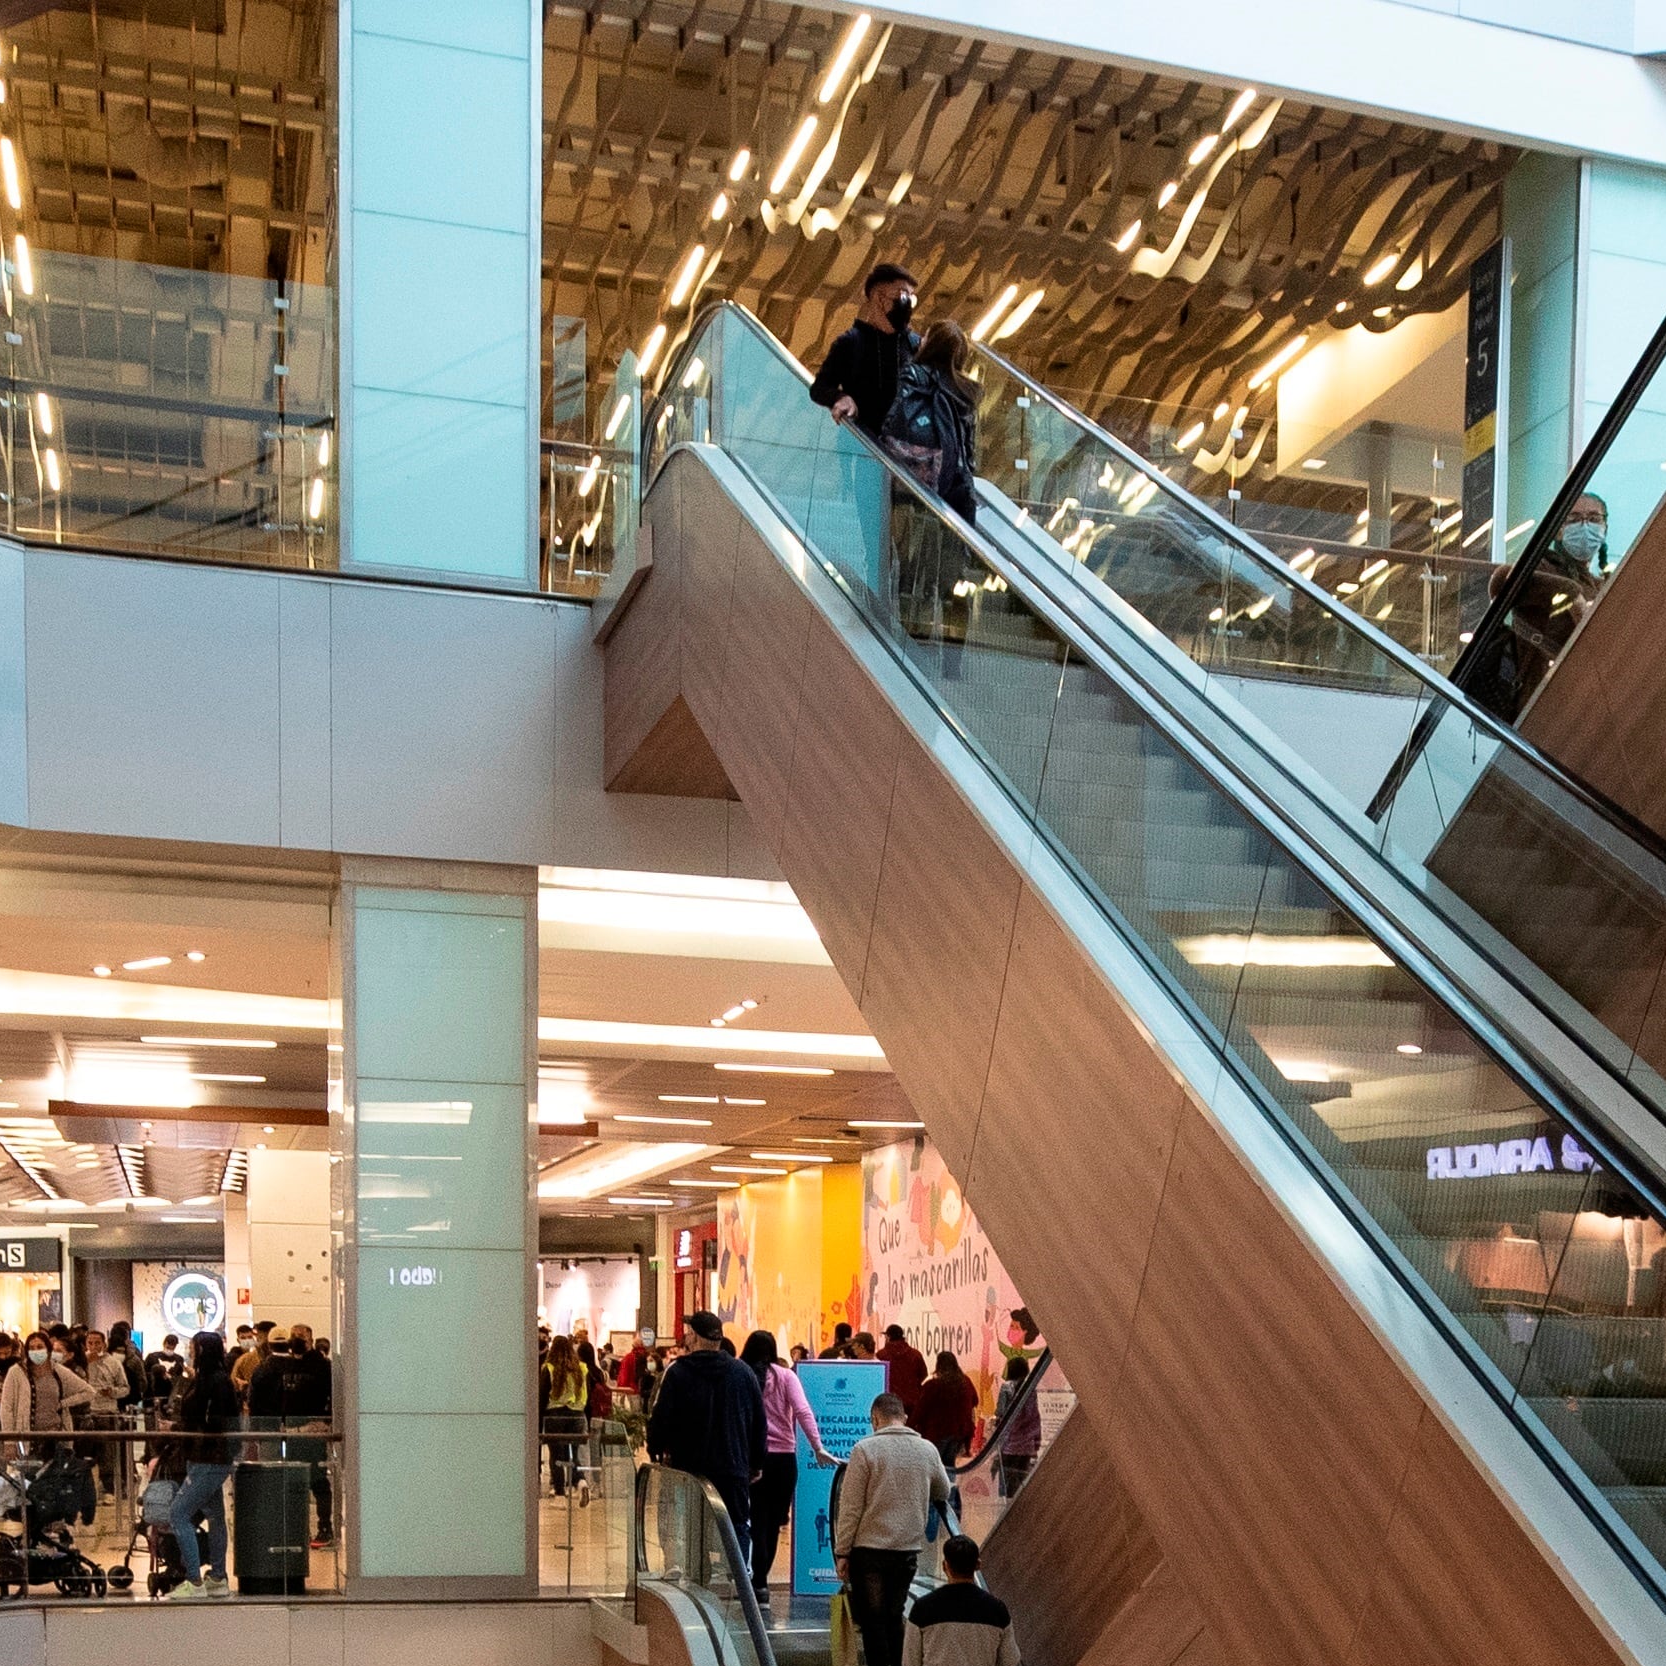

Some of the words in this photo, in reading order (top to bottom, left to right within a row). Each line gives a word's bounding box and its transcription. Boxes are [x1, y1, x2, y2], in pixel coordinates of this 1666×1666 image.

[1477, 338, 1488, 376] 5
[879, 1217, 901, 1254] Que
[888, 1264, 905, 1305] las
[910, 1236, 988, 1299] mascarillas
[926, 1313, 972, 1356] borren
